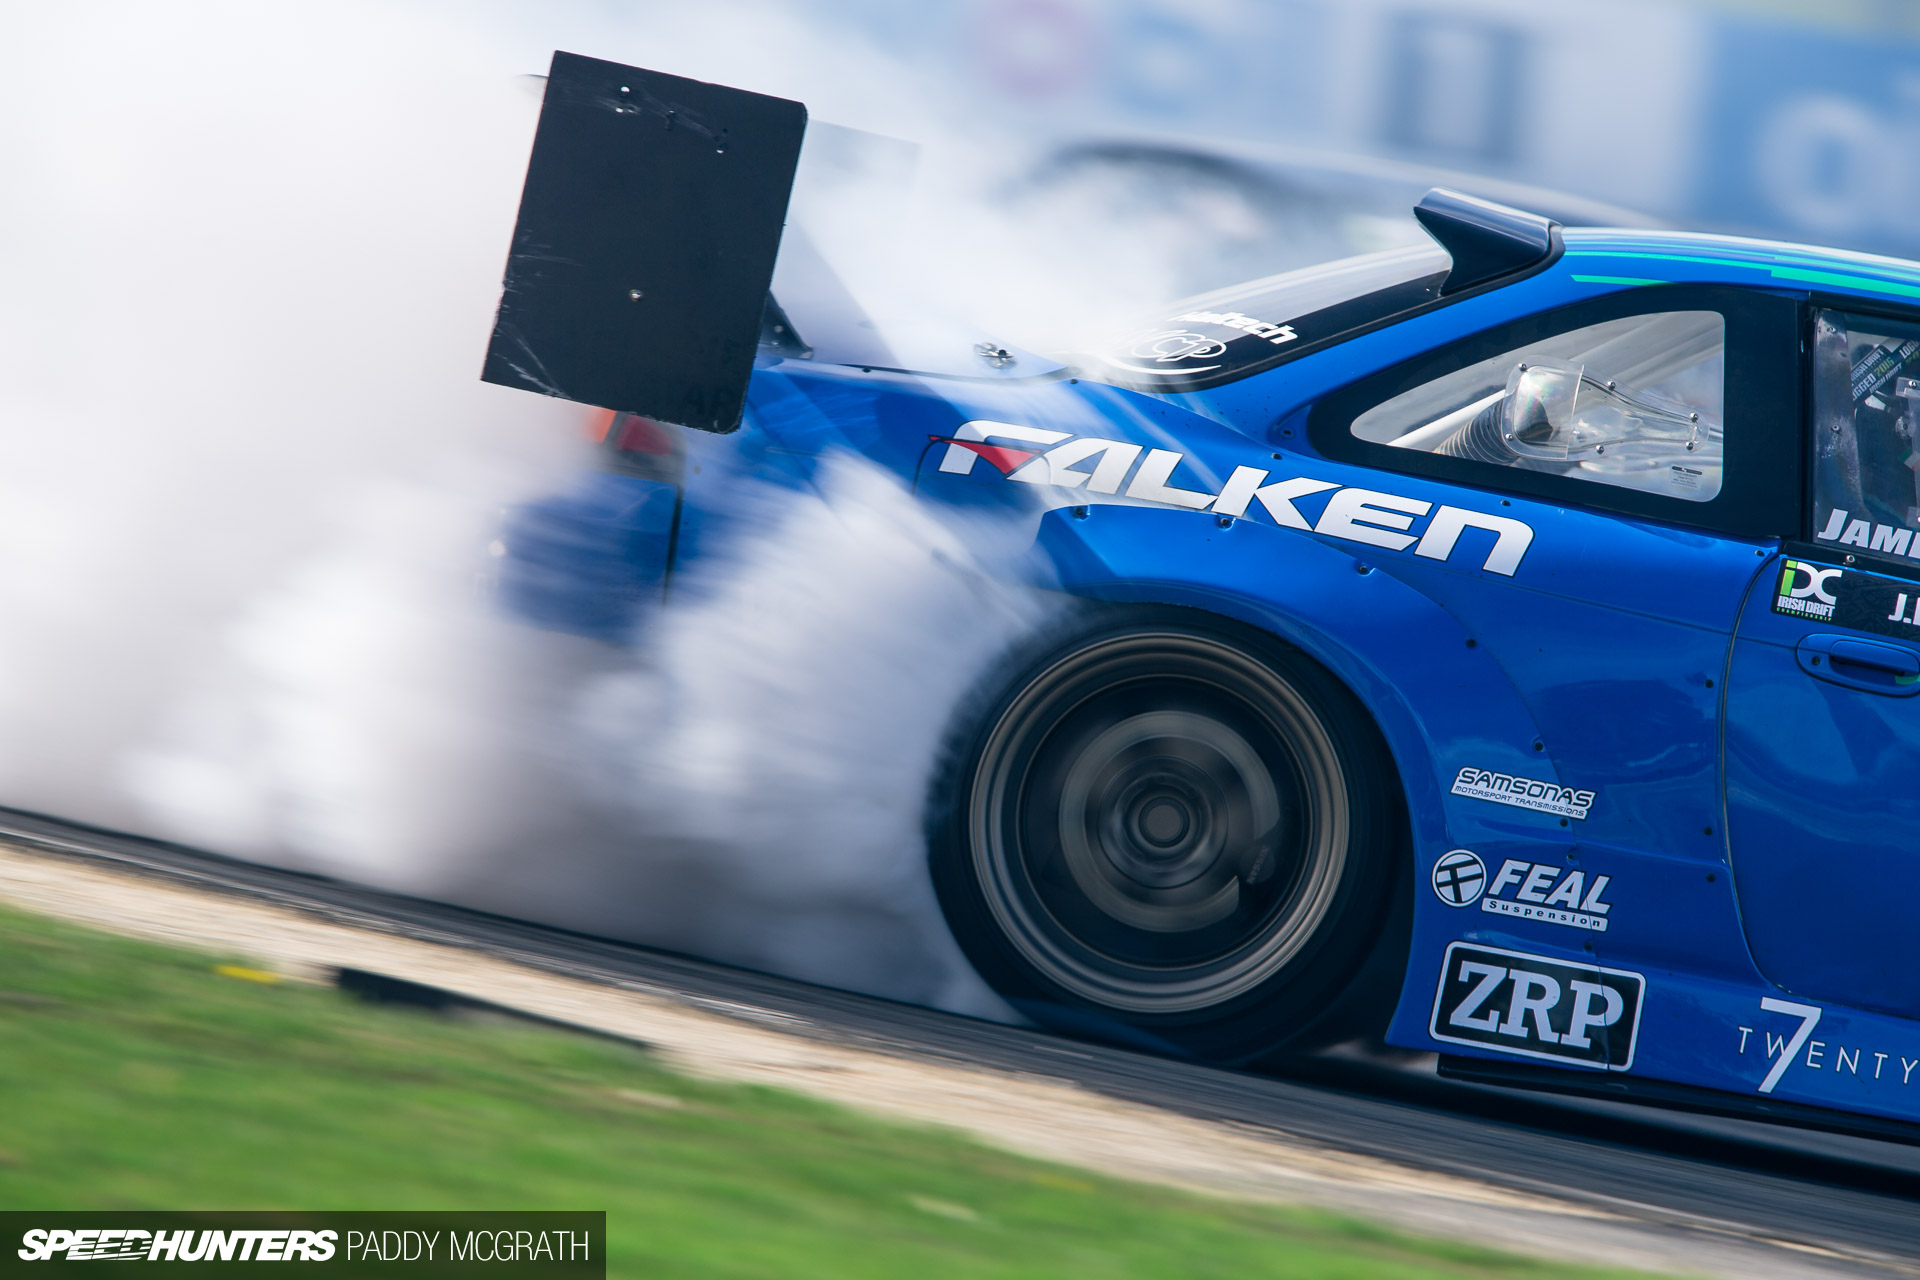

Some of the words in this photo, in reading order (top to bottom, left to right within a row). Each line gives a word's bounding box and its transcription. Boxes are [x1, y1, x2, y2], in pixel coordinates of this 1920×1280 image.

[1852, 373, 1877, 400] GGED
[928, 420, 1535, 577] FALKEN
[1777, 595, 1806, 612] IRISH
[1805, 601, 1836, 617] DRIFT
[1454, 785, 1512, 803] MOTORSPORT
[1515, 796, 1585, 817] TRANSMISSIONS
[1458, 768, 1592, 808] SAMSONAS
[1487, 858, 1613, 915] FEAL
[1489, 900, 1601, 928] Suspension
[1450, 960, 1624, 1049] ZRP
